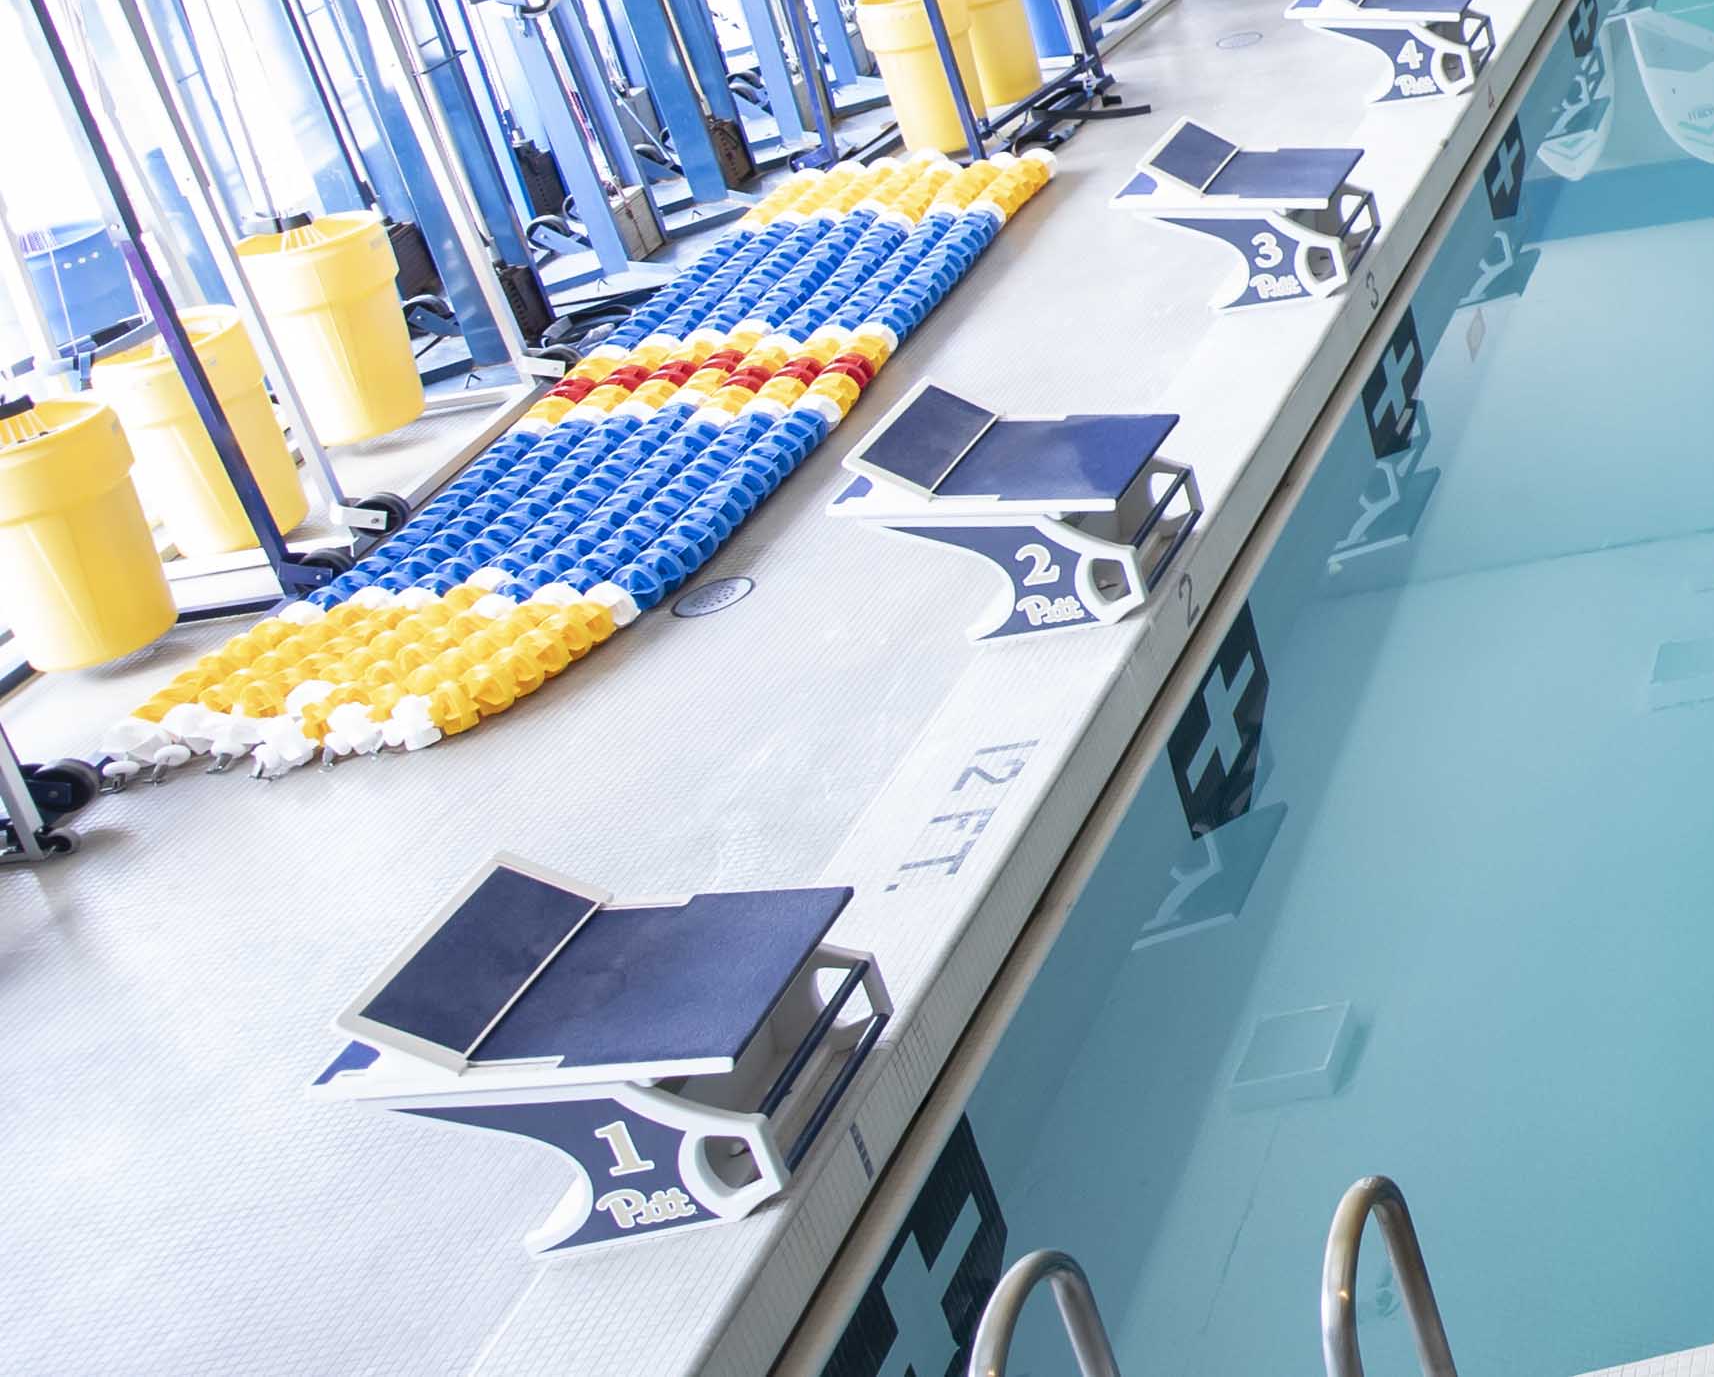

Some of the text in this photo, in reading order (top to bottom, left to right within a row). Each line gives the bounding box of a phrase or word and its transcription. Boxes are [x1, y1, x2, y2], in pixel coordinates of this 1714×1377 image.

[1396, 39, 1424, 70] 4
[1251, 231, 1284, 269] 3
[1250, 273, 1302, 299] Pitt
[1366, 269, 1380, 310] 3
[1014, 543, 1062, 587] 2
[1015, 595, 1085, 626] Pitt
[1178, 572, 1199, 625] 2
[594, 1120, 655, 1176] 1
[595, 1186, 696, 1228] Pitt
